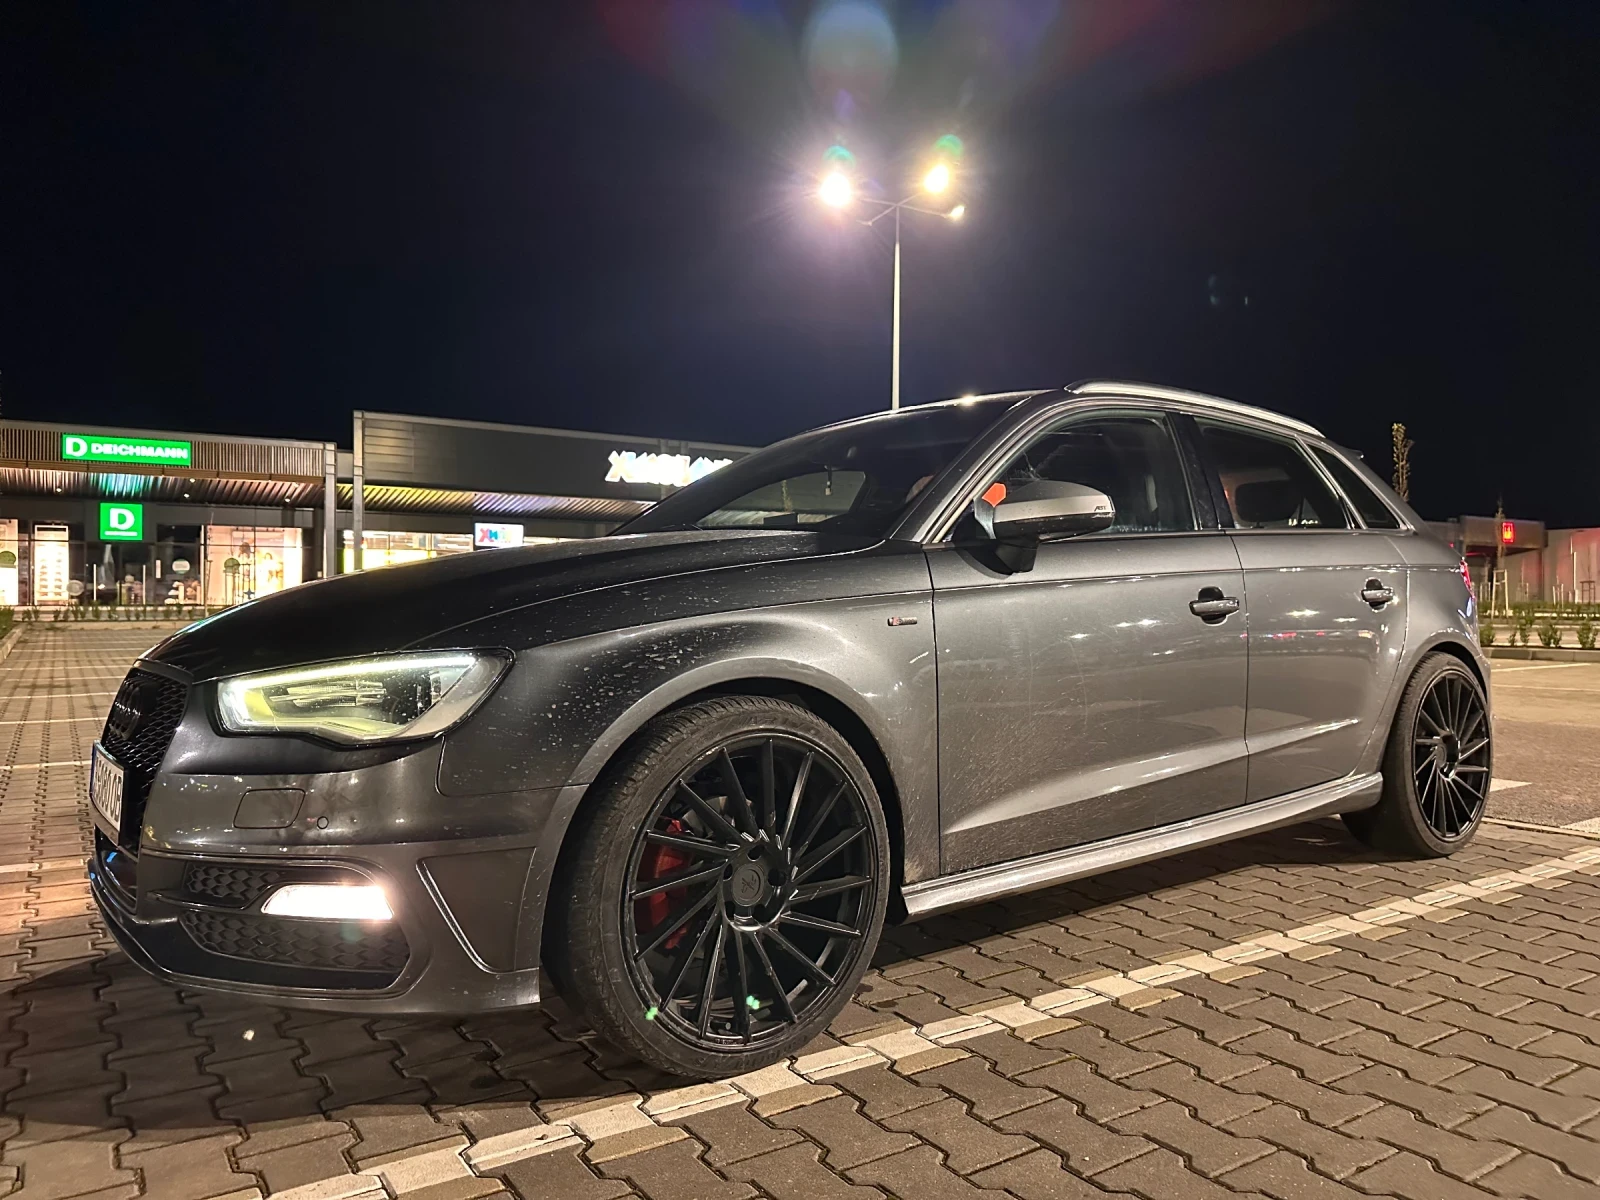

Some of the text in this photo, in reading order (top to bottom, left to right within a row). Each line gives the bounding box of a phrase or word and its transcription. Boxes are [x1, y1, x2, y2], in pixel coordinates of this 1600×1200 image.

[65, 436, 188, 459] D DEICHMANN
[109, 507, 135, 531] D
